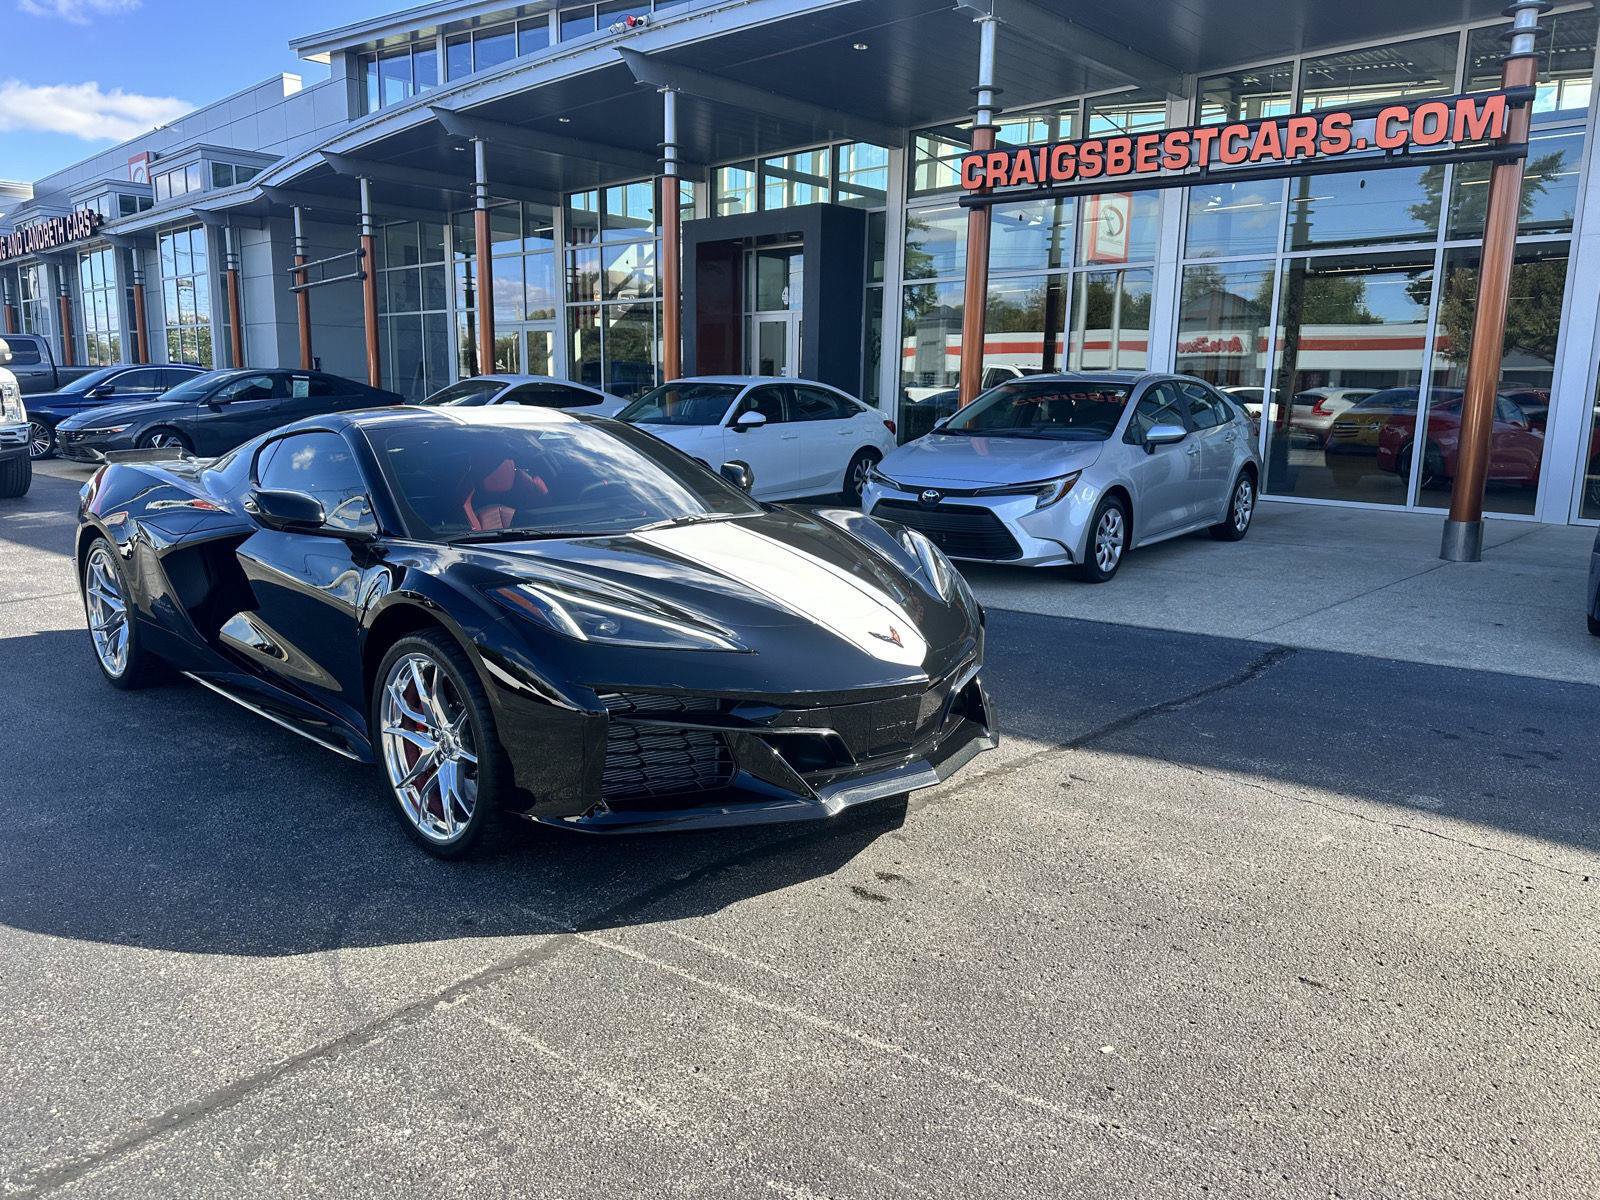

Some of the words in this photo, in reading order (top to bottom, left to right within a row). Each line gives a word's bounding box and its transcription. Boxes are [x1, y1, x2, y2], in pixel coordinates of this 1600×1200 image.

[961, 94, 1507, 191] CRAIGSBESTCARS.COM
[8, 232, 22, 258] AND
[22, 217, 64, 253] LANDRETH
[66, 208, 91, 241] CARS
